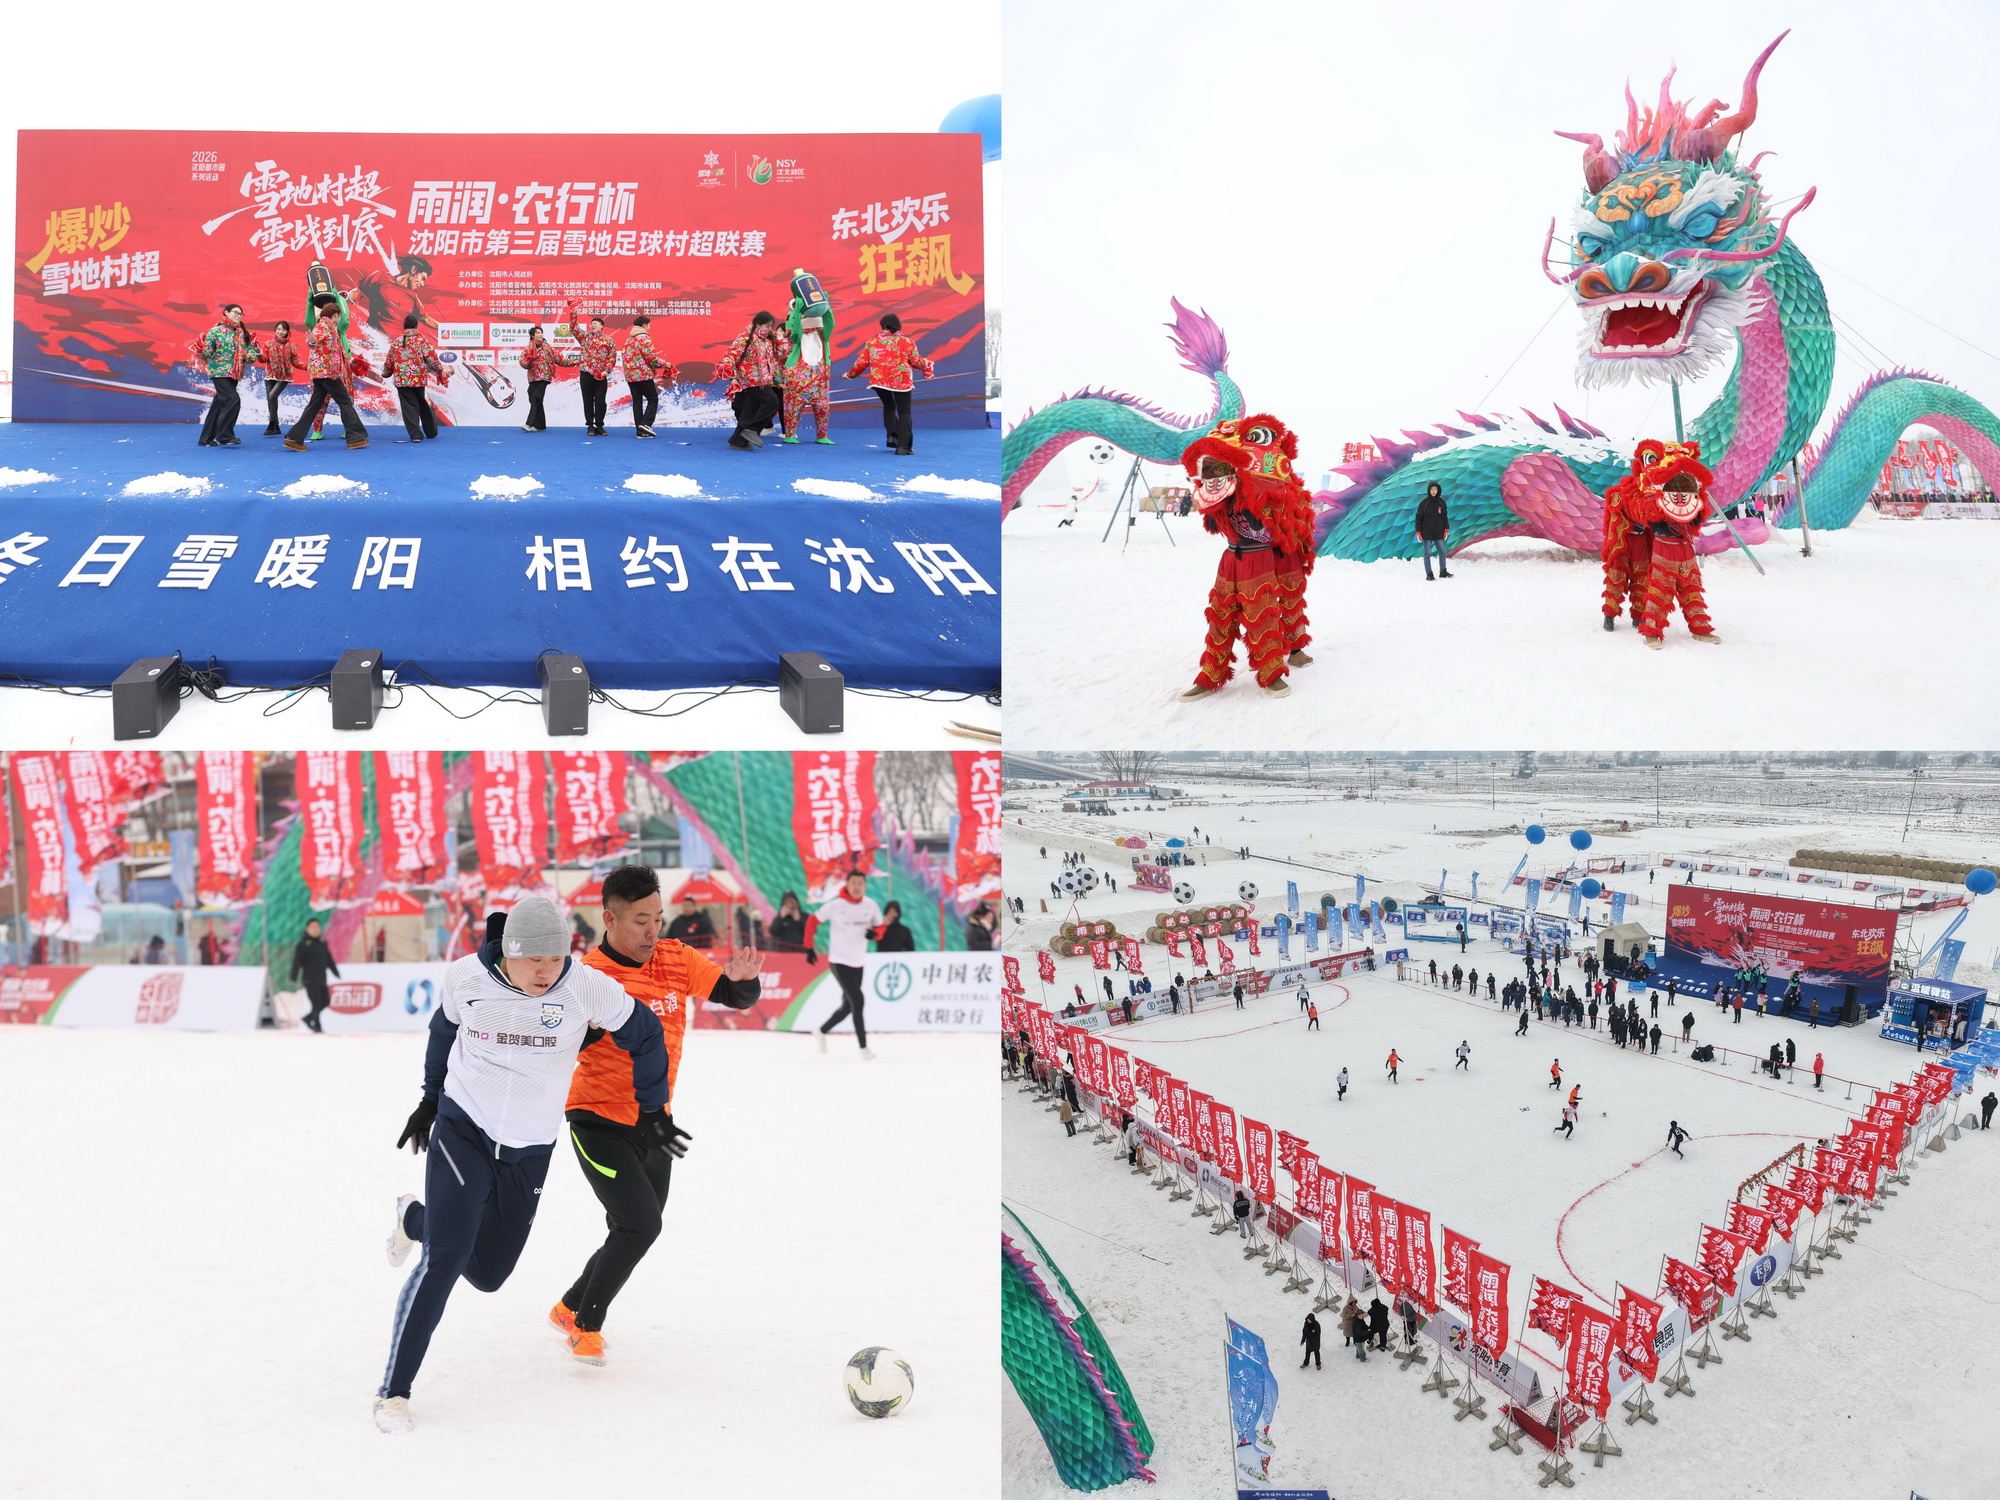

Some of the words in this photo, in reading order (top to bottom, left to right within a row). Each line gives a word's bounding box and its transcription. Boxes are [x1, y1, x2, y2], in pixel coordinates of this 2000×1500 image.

[191, 151, 218, 162] 2026
[776, 159, 797, 168] NSY
[776, 168, 805, 176] 沈北新区
[202, 159, 397, 236] 雪地村超
[408, 180, 639, 226] 雨润·农行杯
[831, 192, 951, 245] 东北欢乐
[25, 201, 131, 274] 爆炒
[248, 206, 401, 276] 雪战到底
[407, 229, 767, 258] 沈阳市第三届雪地足球村超联赛
[41, 250, 161, 297] 雪地村超
[858, 234, 976, 296] 狂飙
[525, 535, 997, 596] 相约在沈阳
[1851, 928, 1885, 941] 东北欢乐
[918, 1008, 985, 1024] 沈阳分行
[496, 1032, 557, 1047] 金贺美口腔
